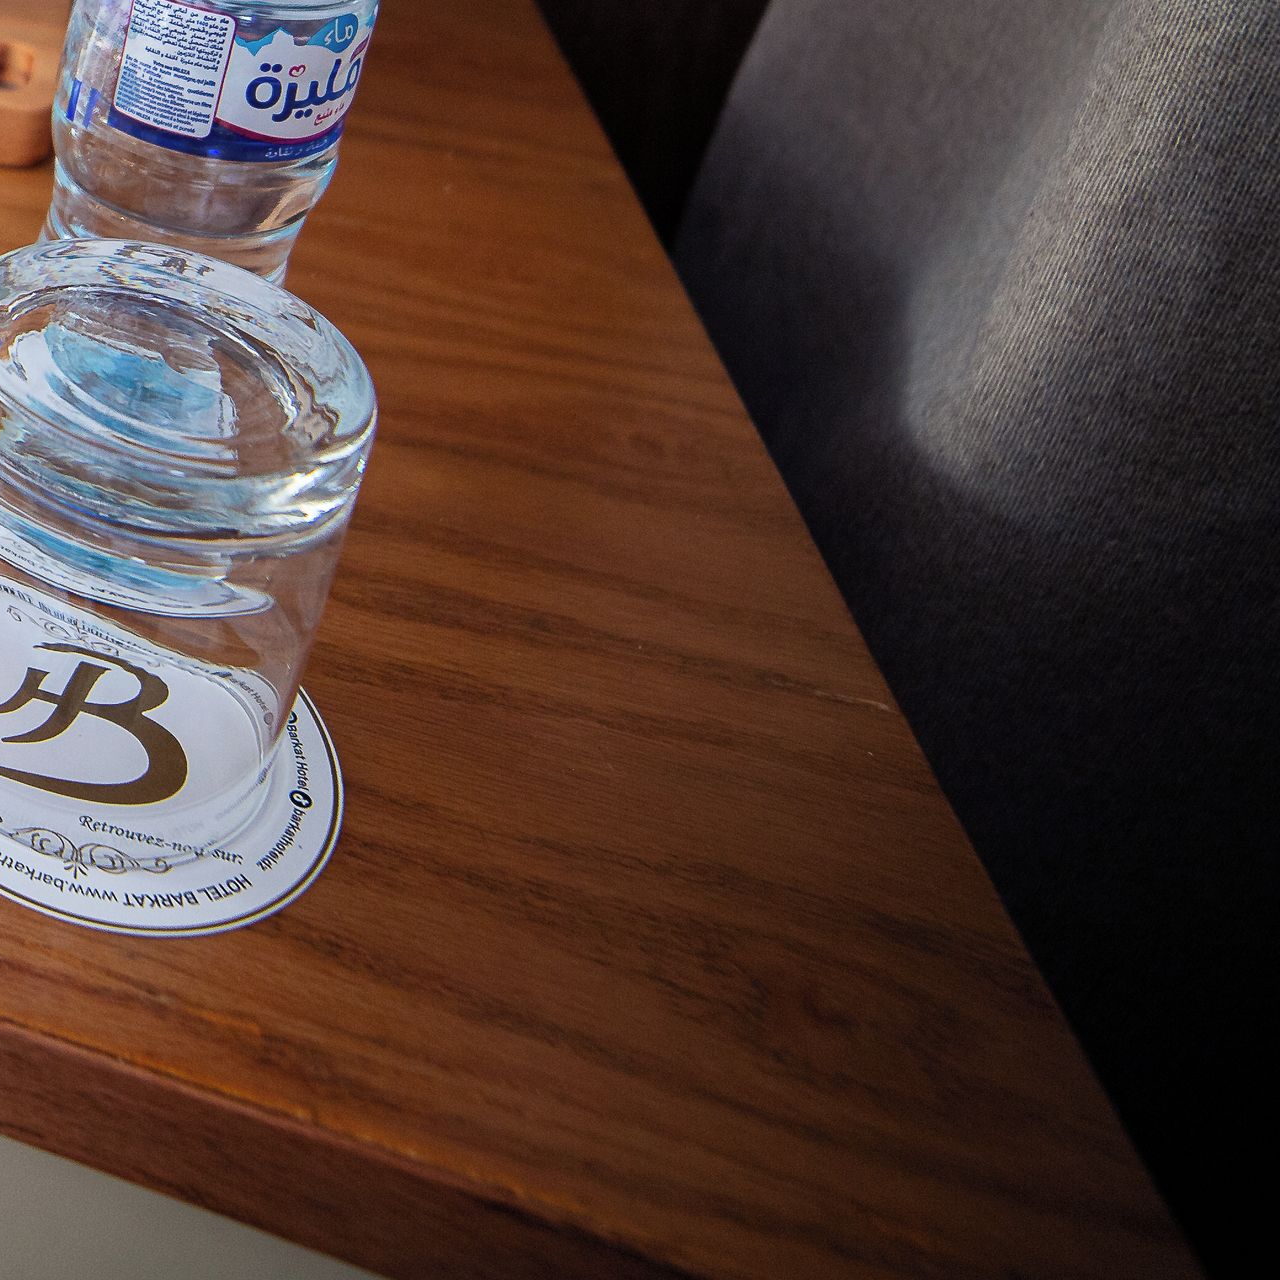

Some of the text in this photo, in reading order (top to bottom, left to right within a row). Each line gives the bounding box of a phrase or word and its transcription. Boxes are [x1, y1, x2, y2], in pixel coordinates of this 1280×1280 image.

[325, 18, 353, 45] ماء
[296, 760, 309, 791] Hotel
[123, 891, 200, 908] BARKAT
[197, 873, 253, 902] HOTEL
